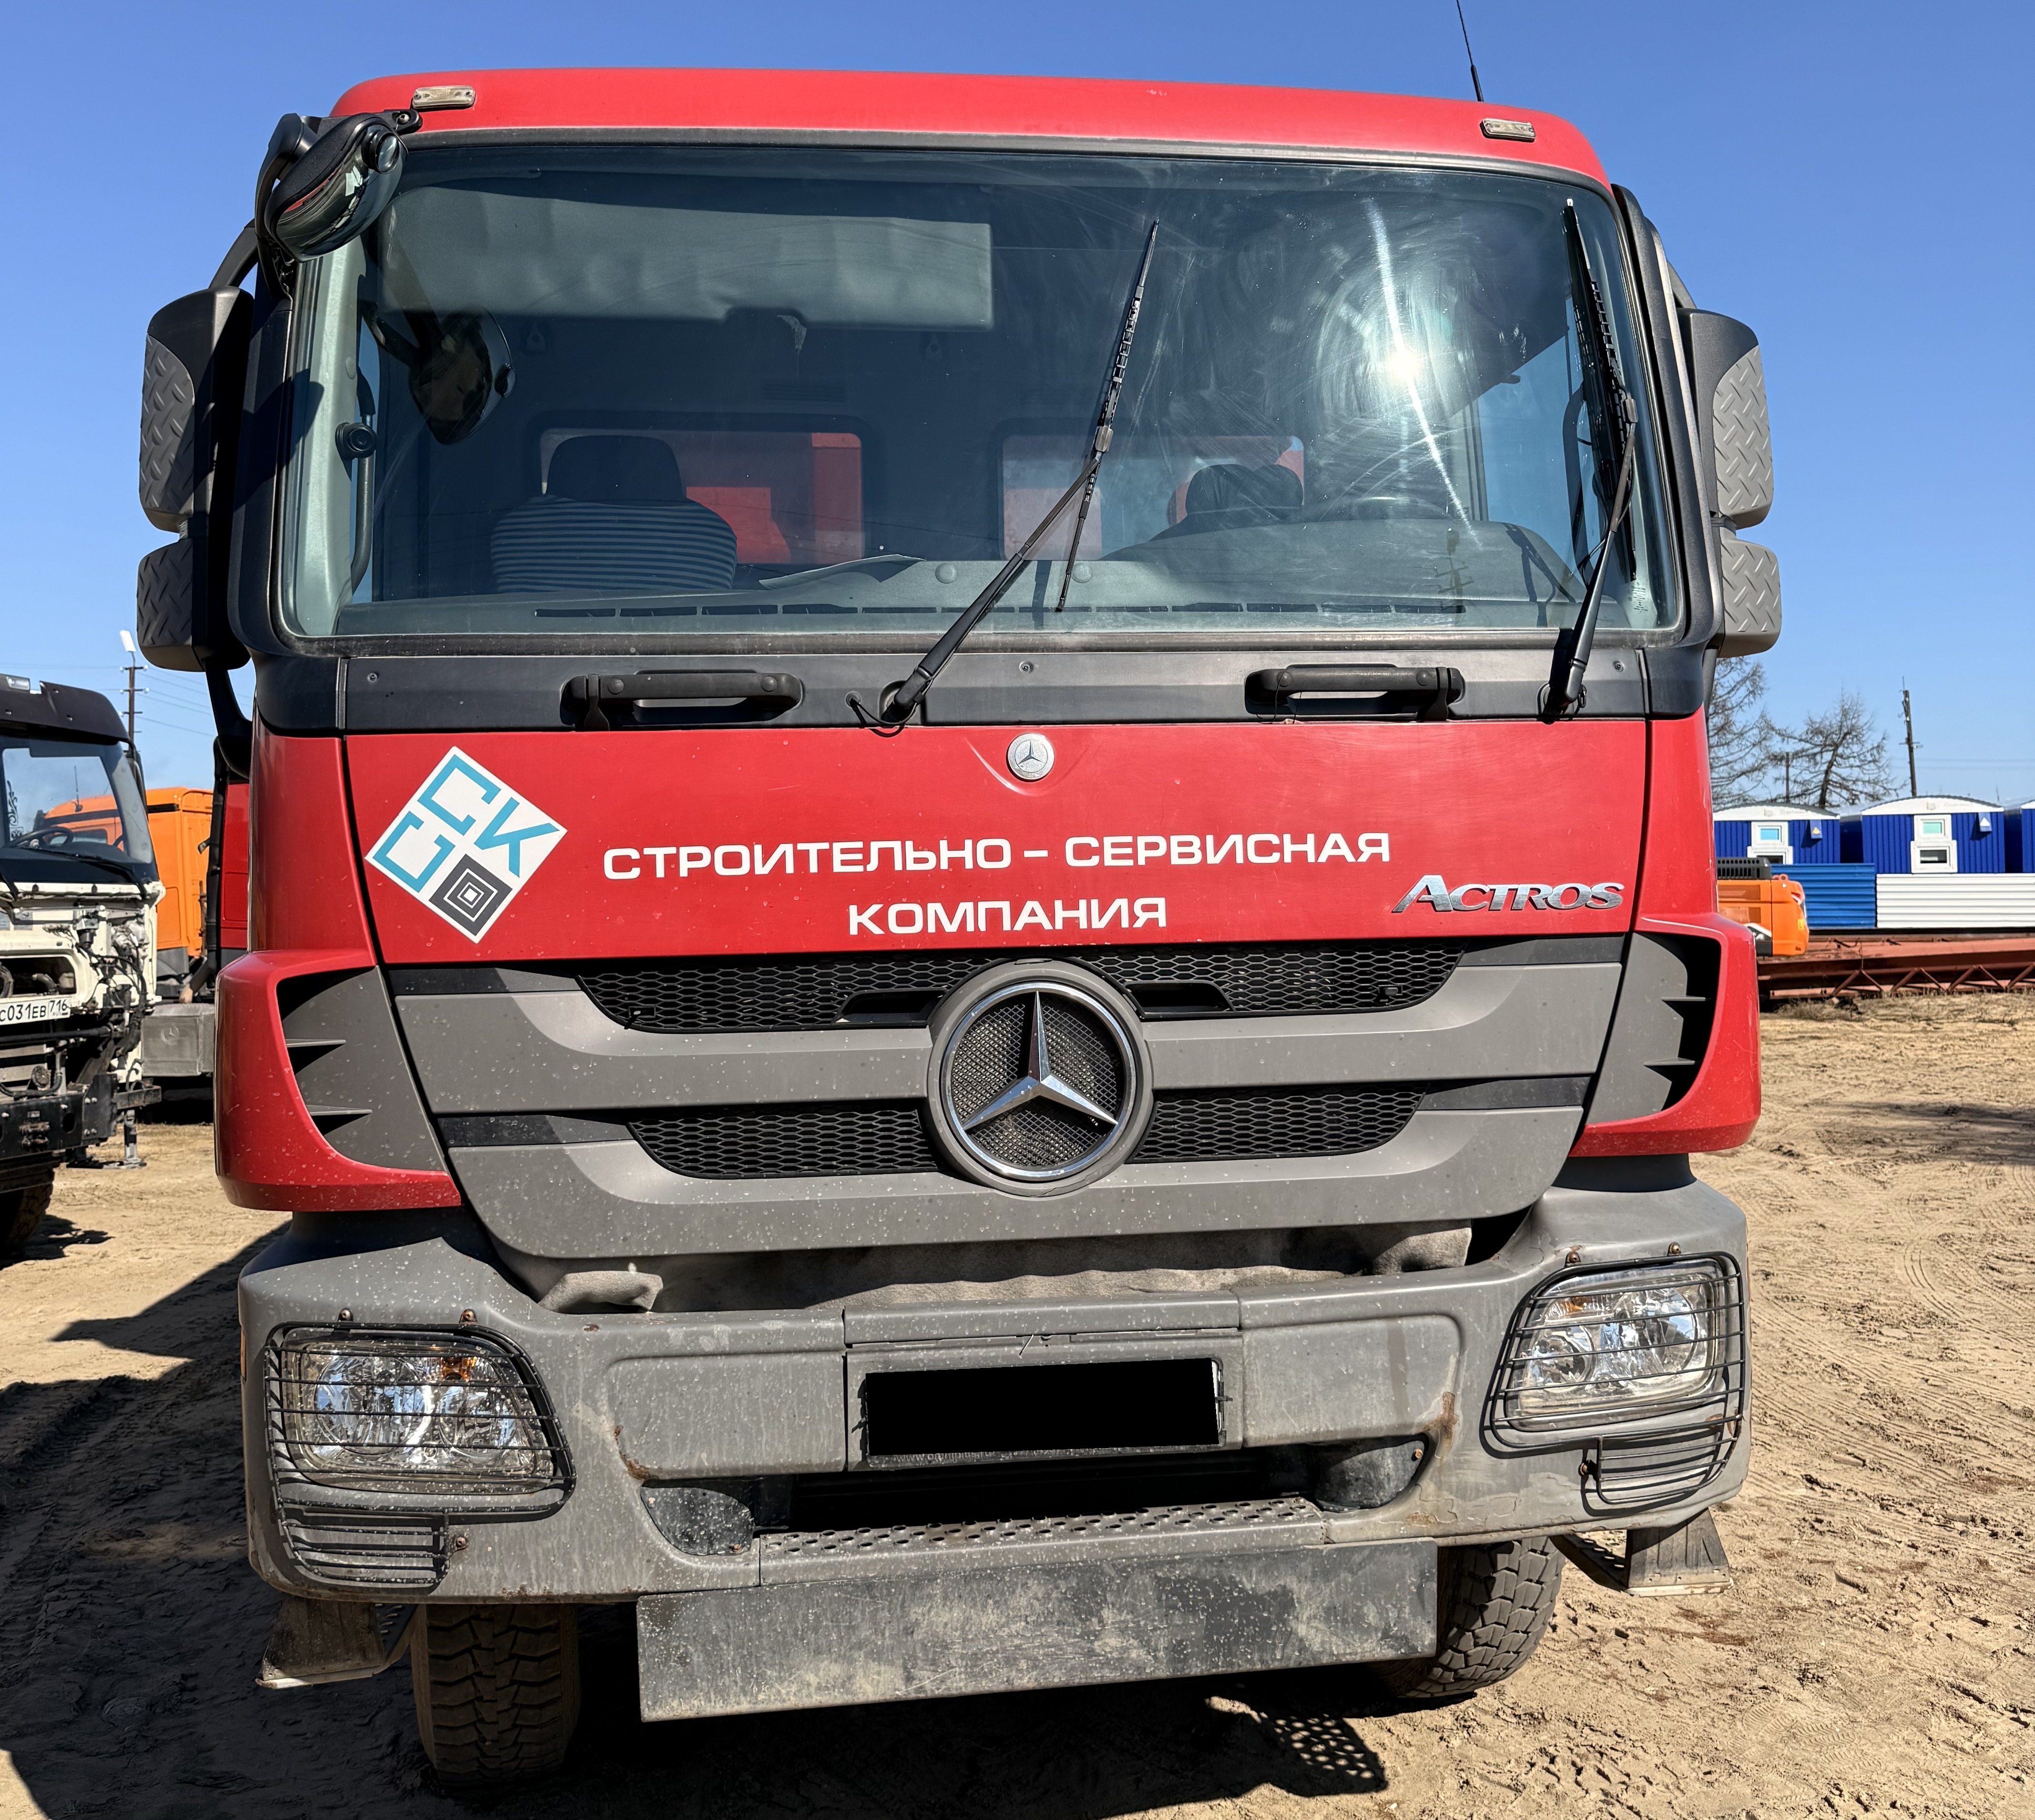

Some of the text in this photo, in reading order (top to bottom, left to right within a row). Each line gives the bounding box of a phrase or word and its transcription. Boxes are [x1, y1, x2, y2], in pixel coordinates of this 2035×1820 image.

[603, 838, 1012, 880] СТРОИТЕЛЬНО
[1064, 832, 1390, 867] СЕРВИСНАЯ
[848, 897, 1167, 936] КОМПАНИЯ
[50, 999, 67, 1012] 716
